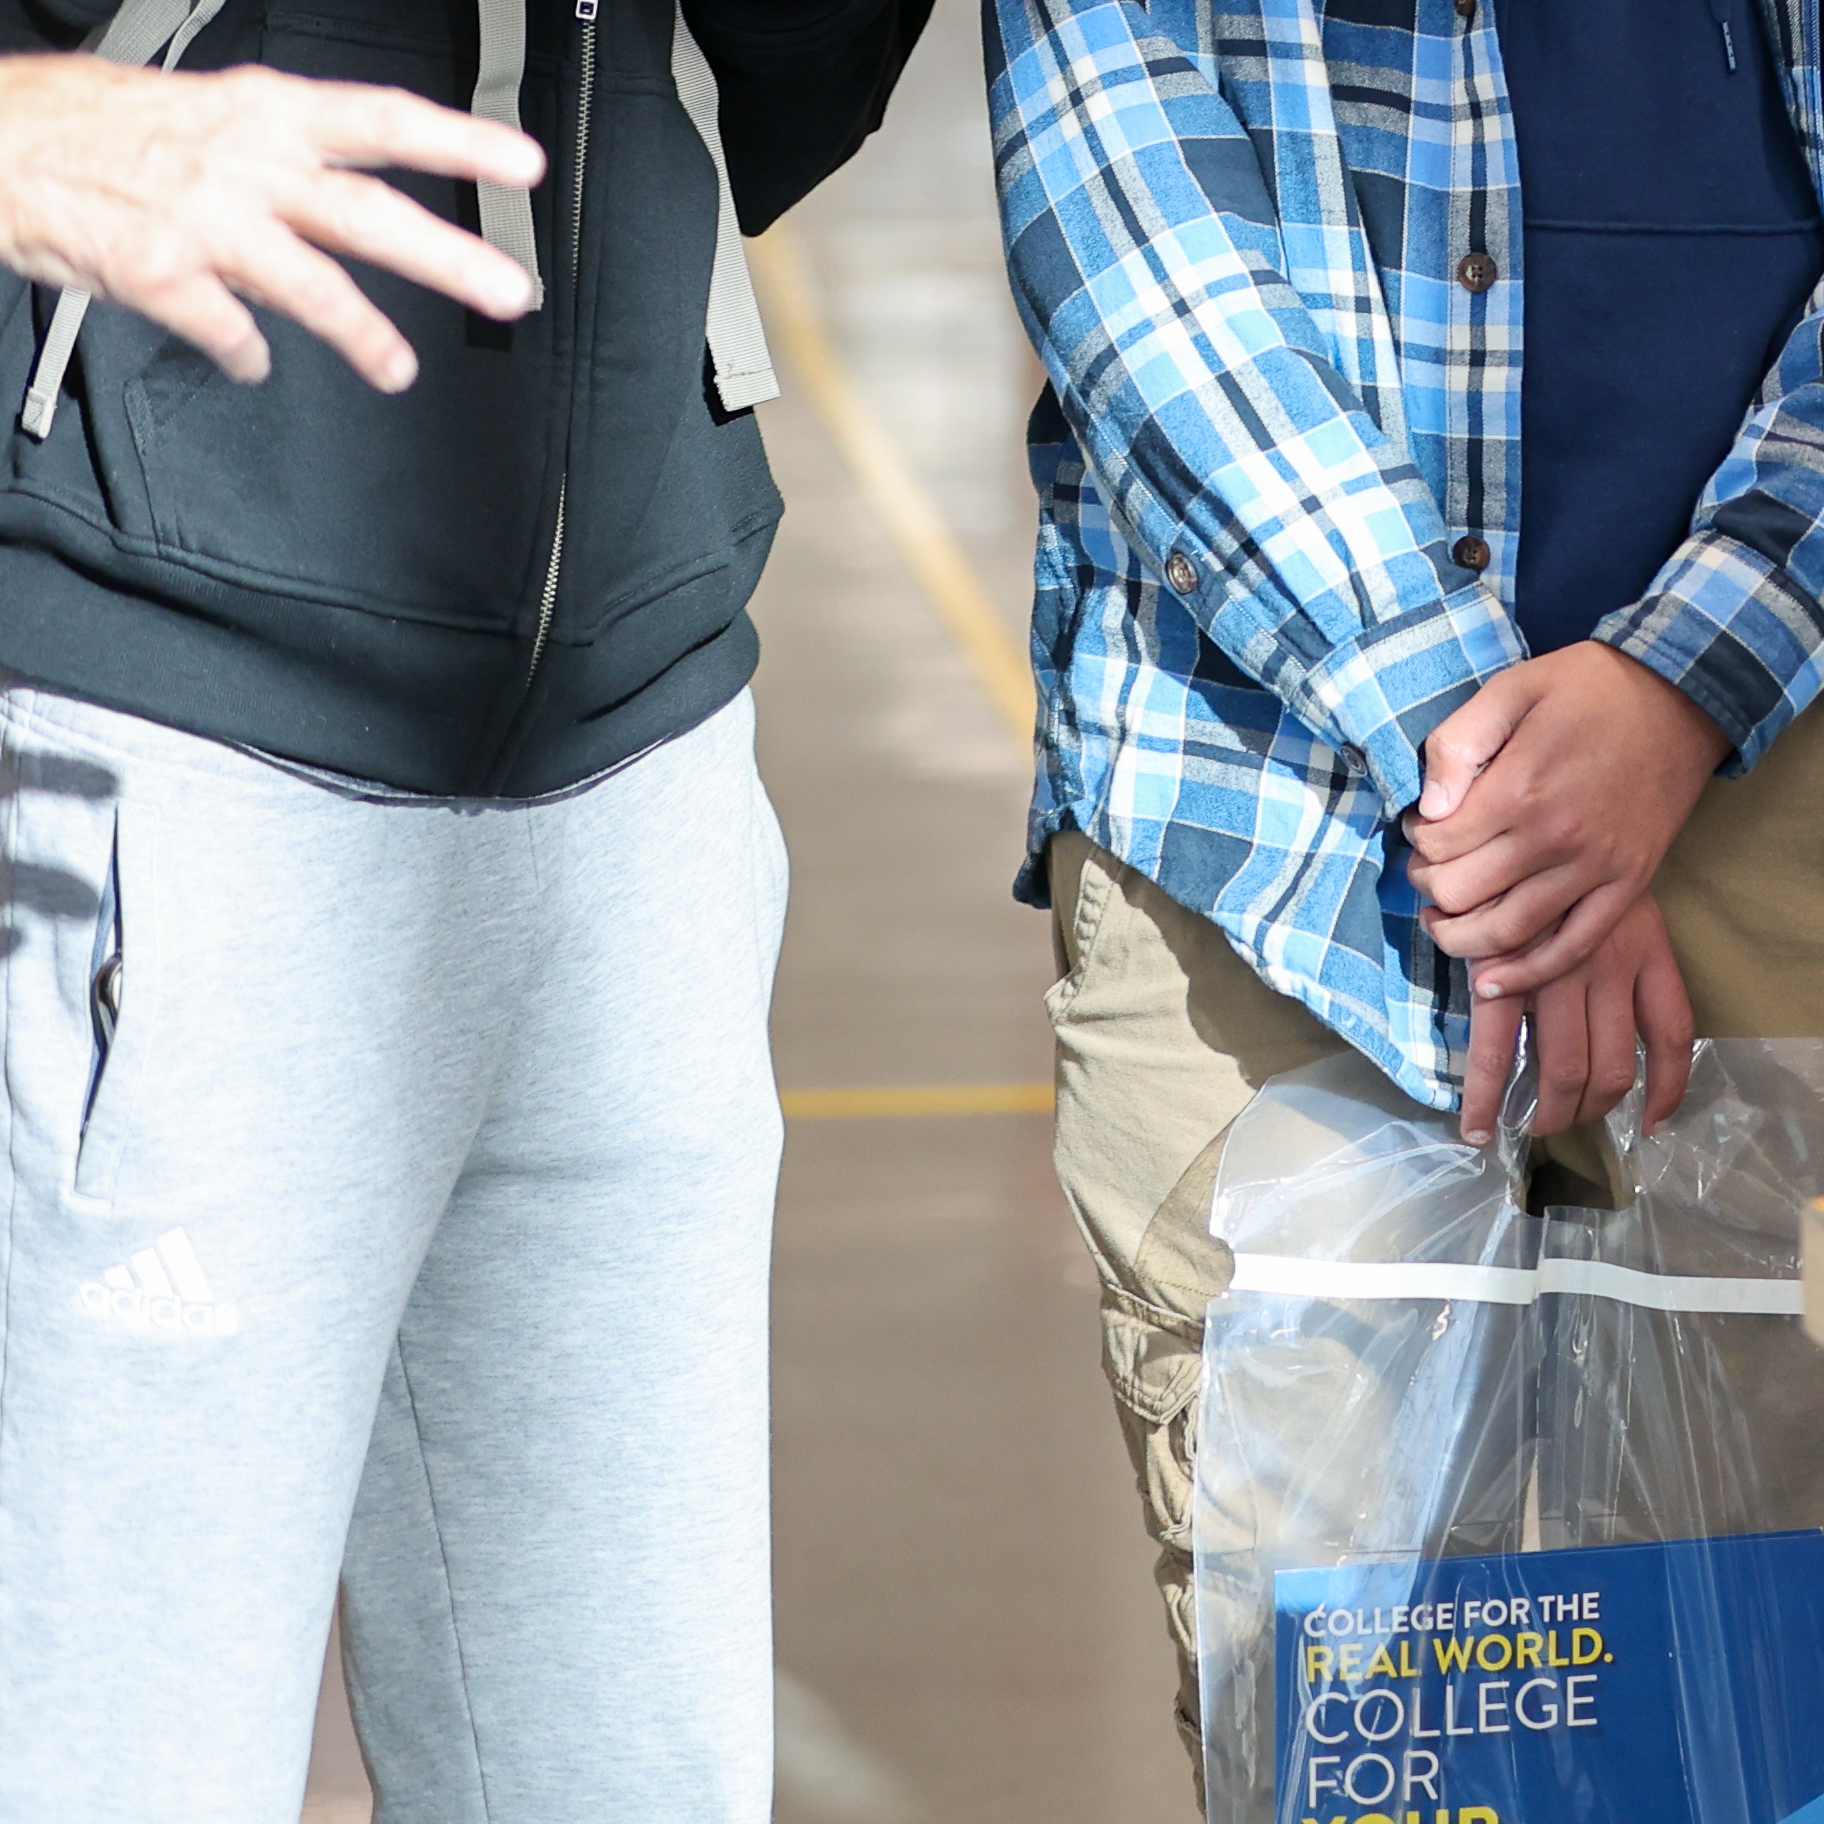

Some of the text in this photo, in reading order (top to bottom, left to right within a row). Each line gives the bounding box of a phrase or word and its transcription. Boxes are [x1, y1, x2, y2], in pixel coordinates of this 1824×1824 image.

[80, 1280, 239, 1337] adidas
[1303, 1591, 1600, 1639] COLLEGE FOR THE
[1306, 1627, 1614, 1684] REAL WORLD.
[1305, 1674, 1598, 1745] COLLEGE
[1308, 1749, 1439, 1809] FOR
